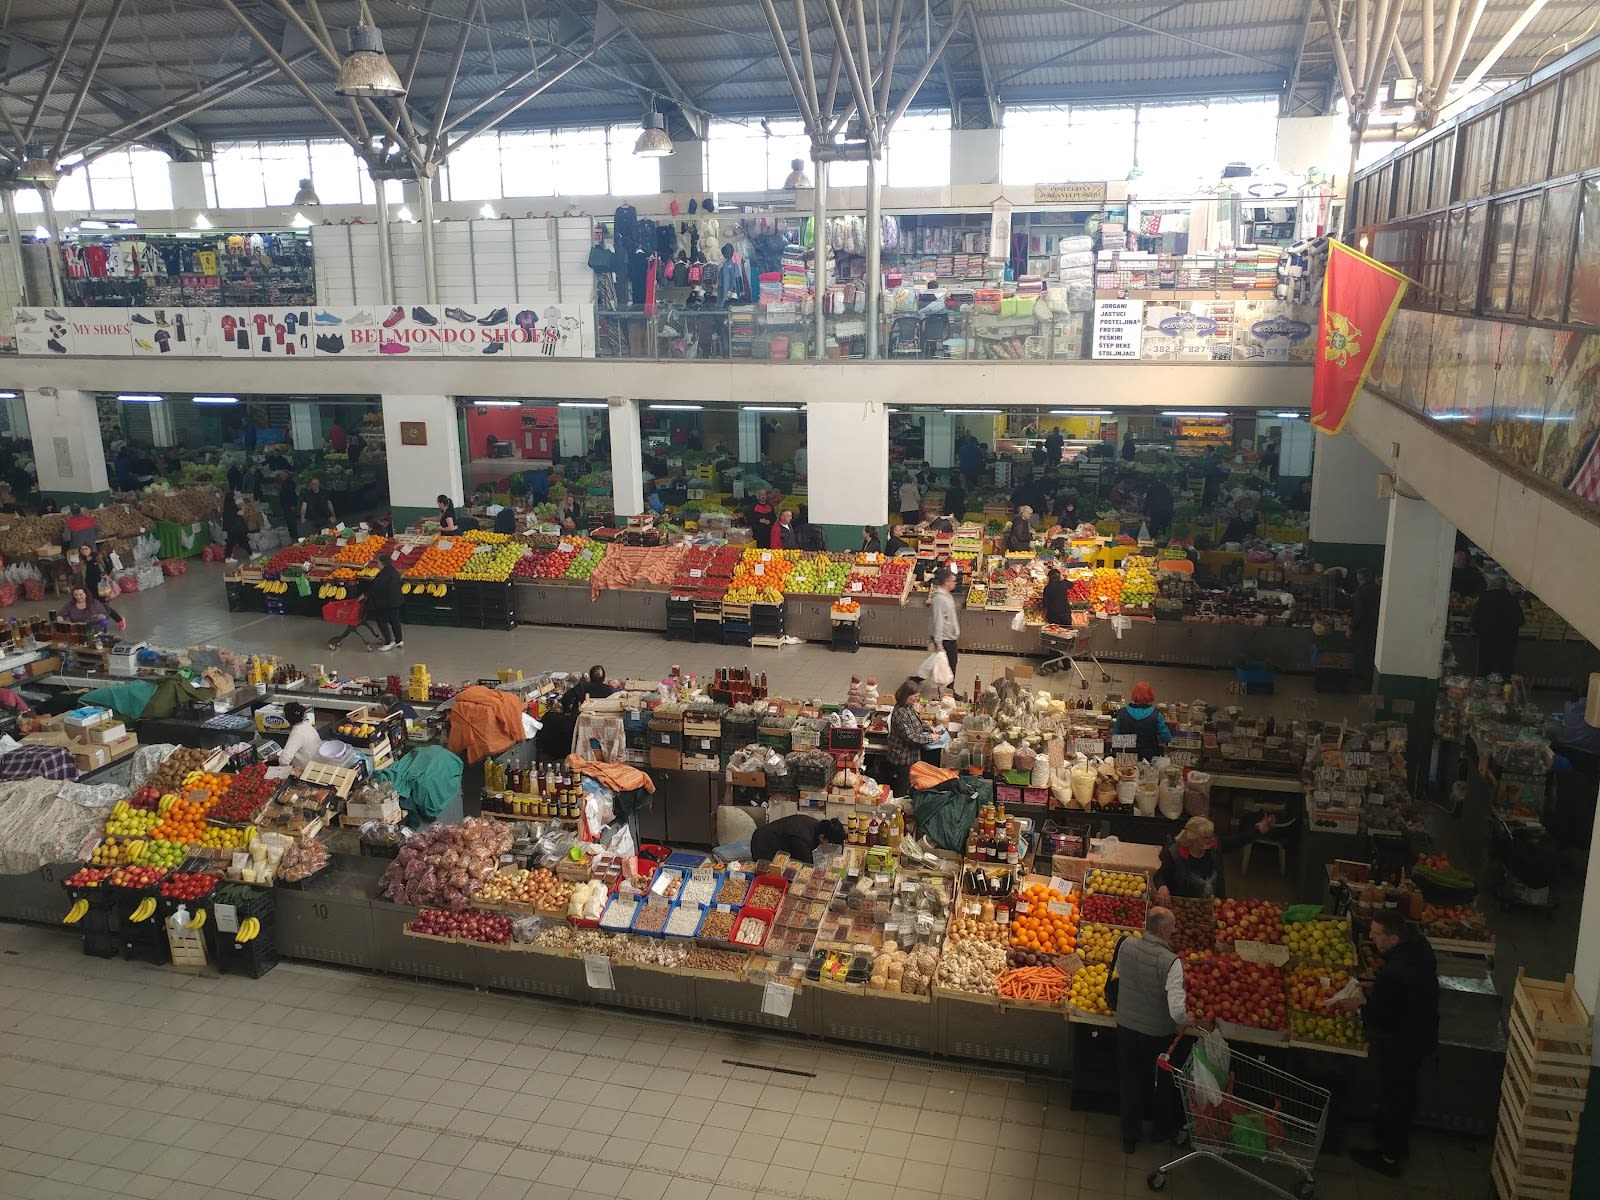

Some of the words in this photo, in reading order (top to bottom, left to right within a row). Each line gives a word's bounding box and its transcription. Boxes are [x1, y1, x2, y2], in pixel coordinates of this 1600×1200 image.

[72, 322, 90, 335] MY
[93, 322, 130, 335] SHOES
[351, 328, 476, 344] BELMONDO
[481, 327, 560, 344] SHOES
[810, 607, 820, 616] 14
[867, 610, 876, 619] 13
[985, 617, 995, 627] 11
[312, 903, 328, 920] 10
